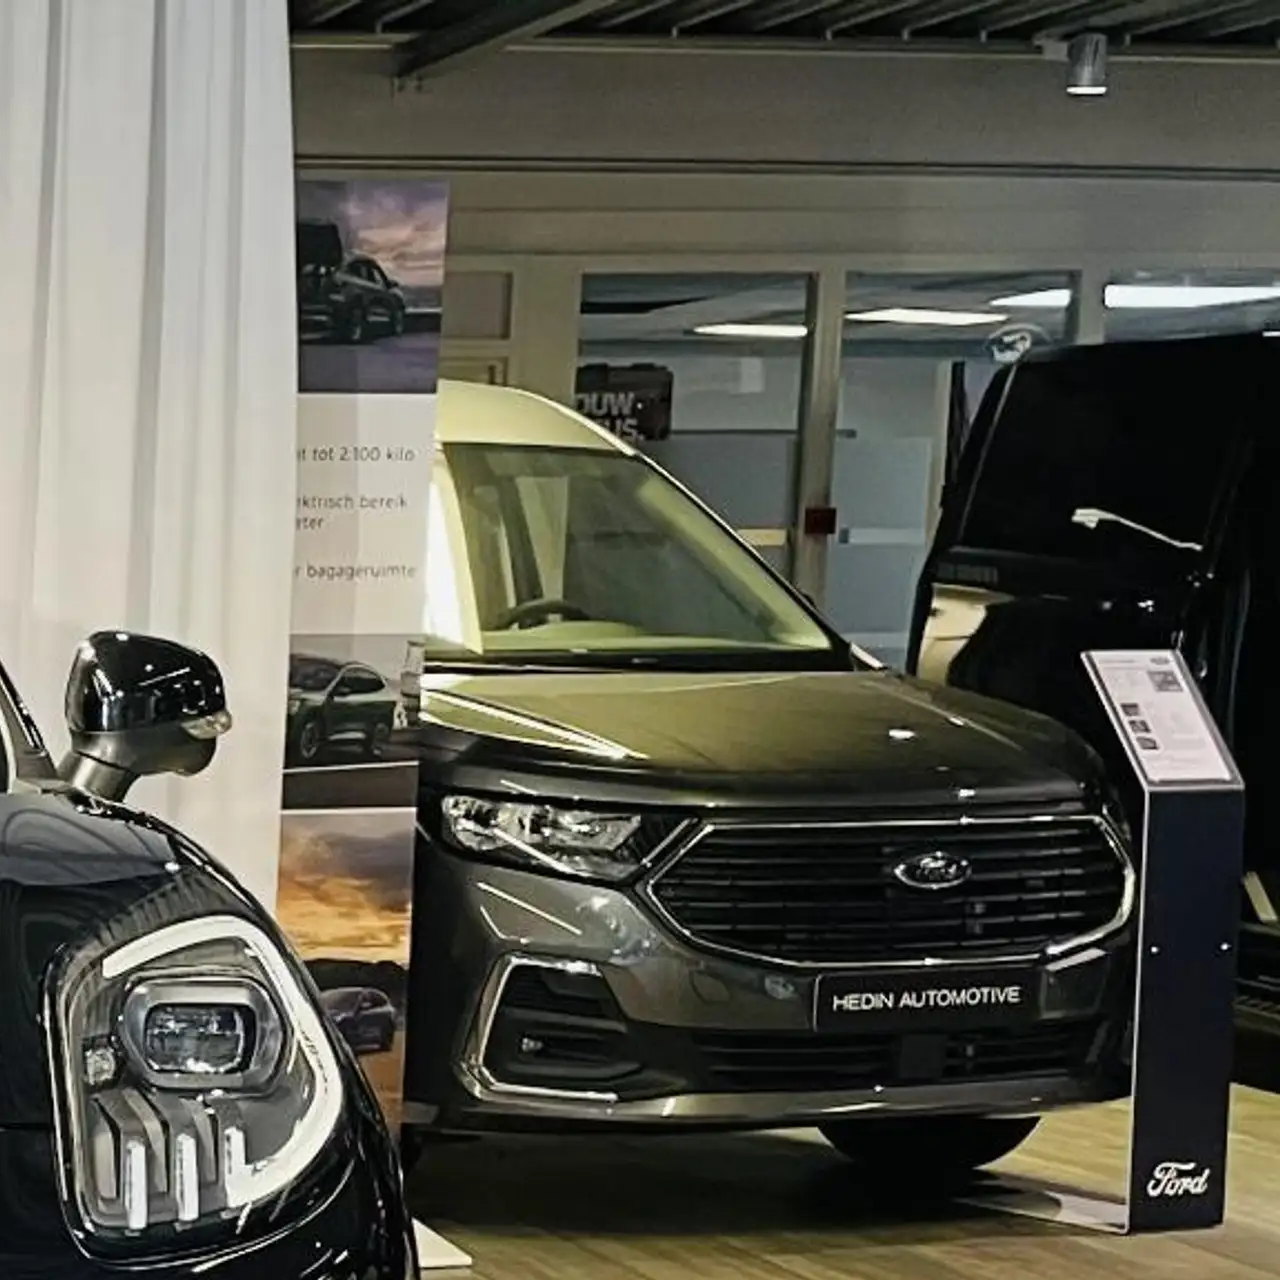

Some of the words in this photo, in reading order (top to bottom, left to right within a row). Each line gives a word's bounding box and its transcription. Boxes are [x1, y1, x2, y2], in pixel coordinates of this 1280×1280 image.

[312, 446, 336, 461] tot
[386, 445, 416, 461] kilo
[305, 561, 417, 581] bagageruimte
[832, 991, 895, 1012] HEDIN
[898, 986, 1022, 1009] AUTOMOTIVE
[1146, 1161, 1211, 1197] Ford
